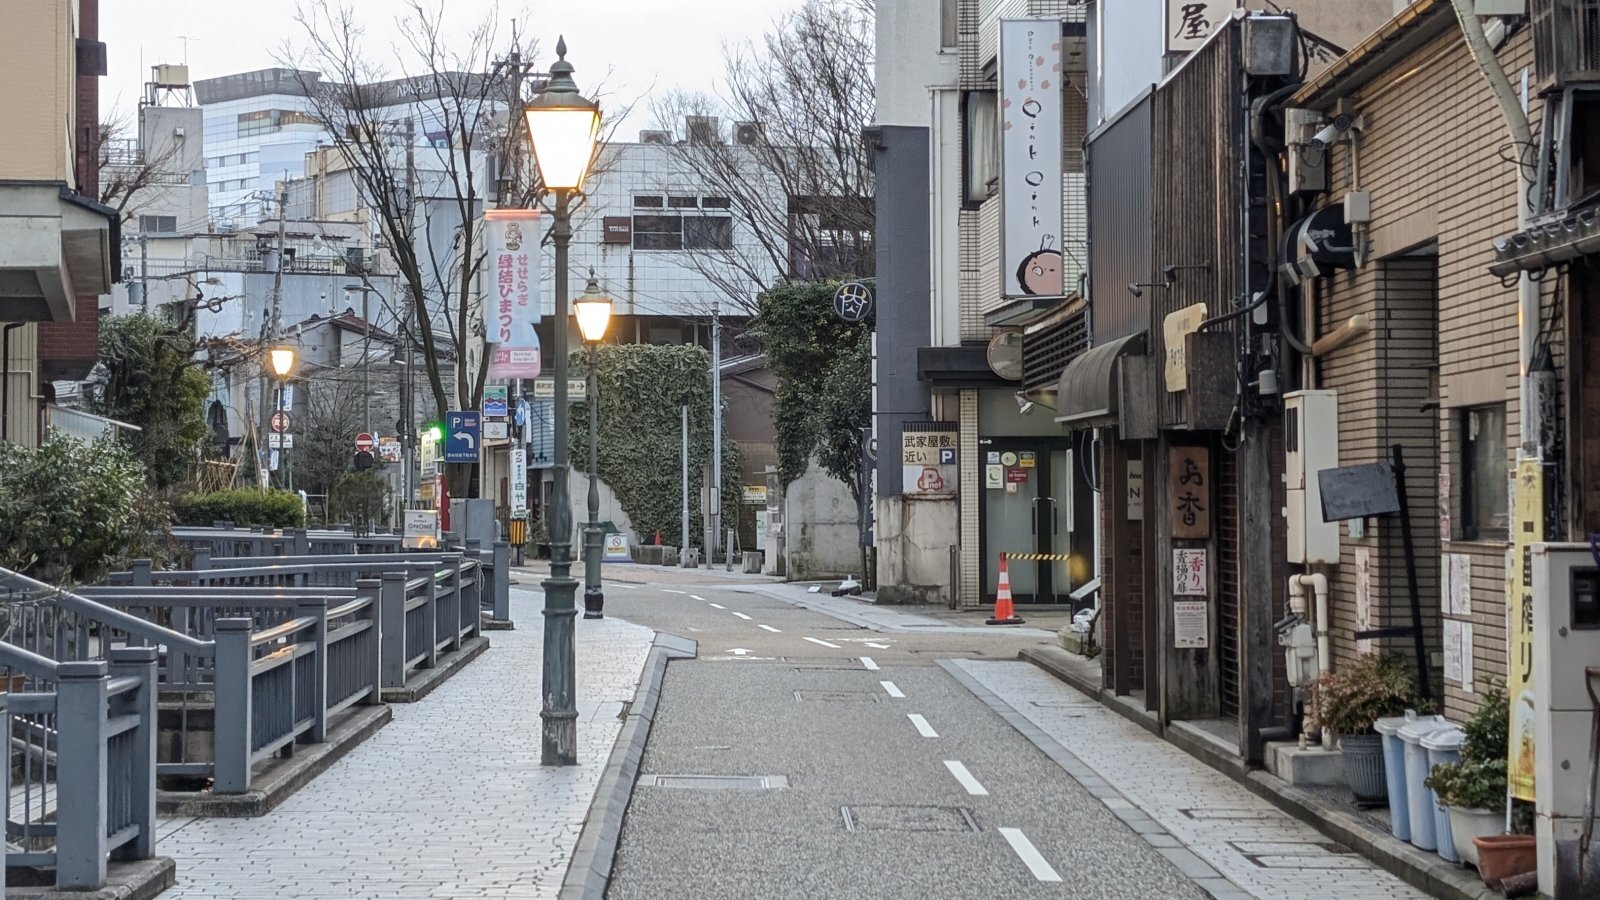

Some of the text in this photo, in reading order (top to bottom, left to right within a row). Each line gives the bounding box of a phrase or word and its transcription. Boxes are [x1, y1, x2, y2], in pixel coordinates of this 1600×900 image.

[1174, 3, 1209, 40] 屋
[498, 254, 513, 342] 縁結びまつり
[517, 254, 528, 307] せせらぎ
[453, 417, 460, 428] P
[904, 451, 952, 463] 近い P
[1176, 457, 1205, 526] お香
[1189, 557, 1204, 587] 香り
